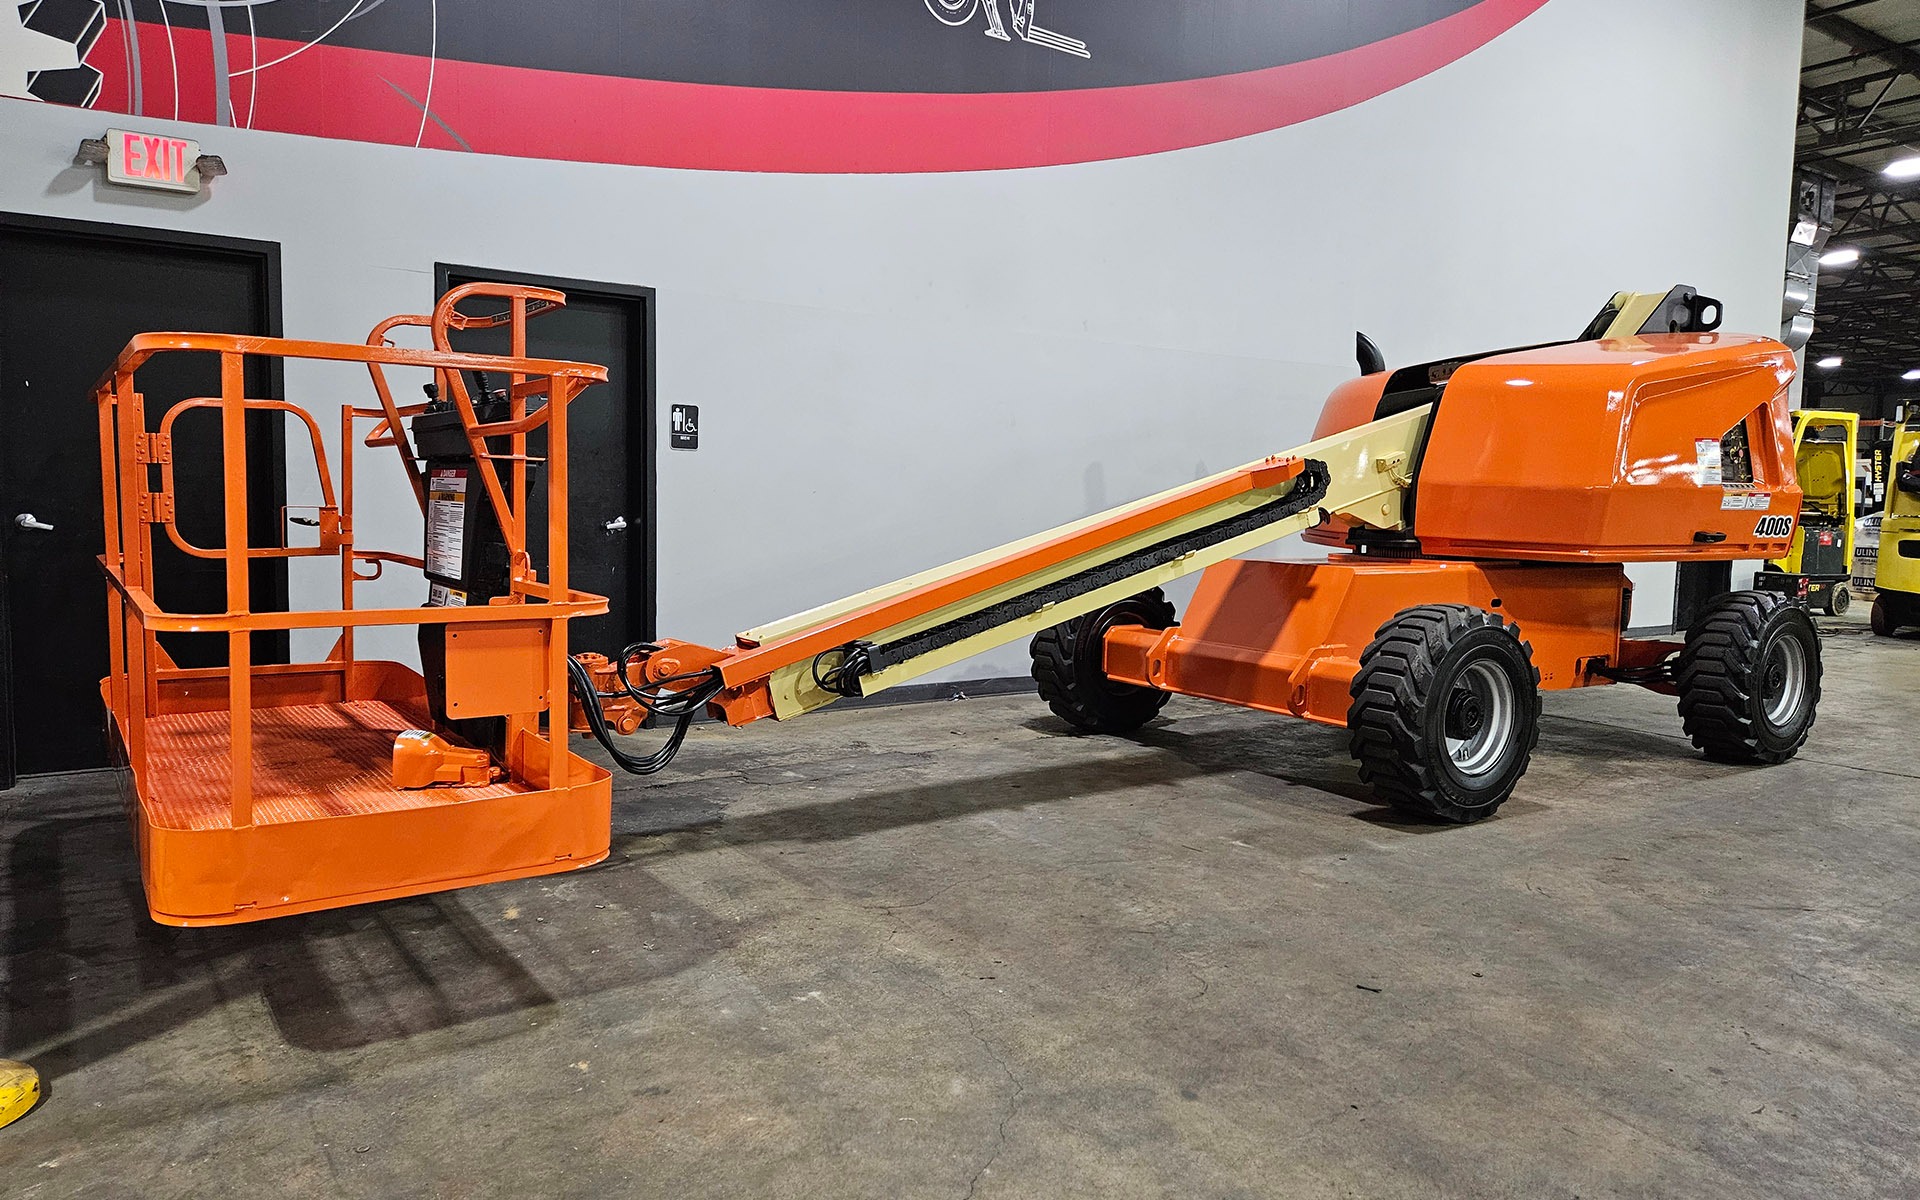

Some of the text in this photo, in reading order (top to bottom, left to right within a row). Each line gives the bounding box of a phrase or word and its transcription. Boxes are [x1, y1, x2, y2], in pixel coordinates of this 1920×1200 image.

[124, 134, 187, 183] EXIT
[1874, 449, 1882, 482] HYSTER
[1754, 516, 1792, 537] 400S
